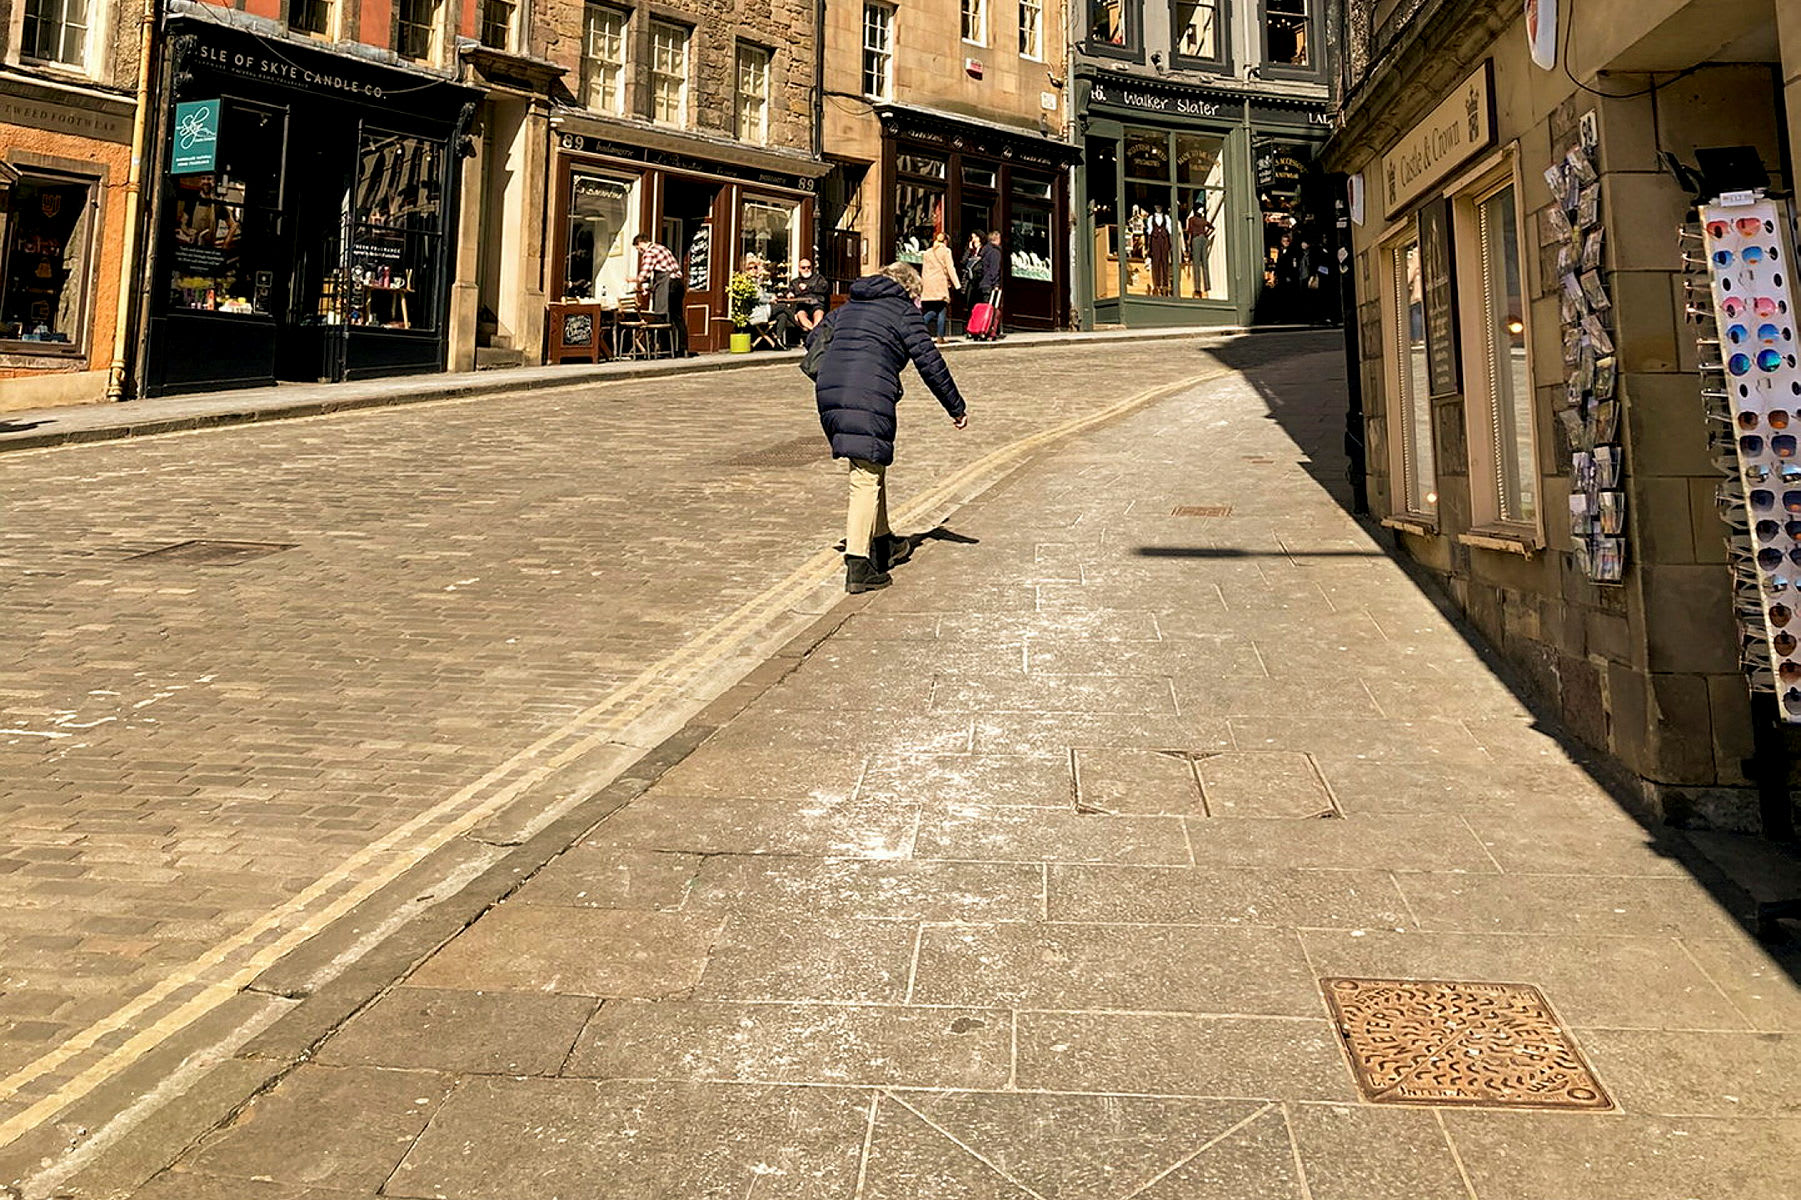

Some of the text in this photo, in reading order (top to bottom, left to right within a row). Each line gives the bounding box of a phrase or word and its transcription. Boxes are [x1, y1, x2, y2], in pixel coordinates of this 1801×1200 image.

[195, 46, 227, 63] SLE
[234, 53, 254, 68] OF
[260, 60, 298, 79] SKYE
[303, 70, 360, 93] CANDLE
[1123, 91, 1169, 110] Walker
[1177, 99, 1220, 116] Slater
[562, 133, 585, 150] 89
[1401, 120, 1461, 188] Castle & Crown
[798, 176, 815, 192] 89
